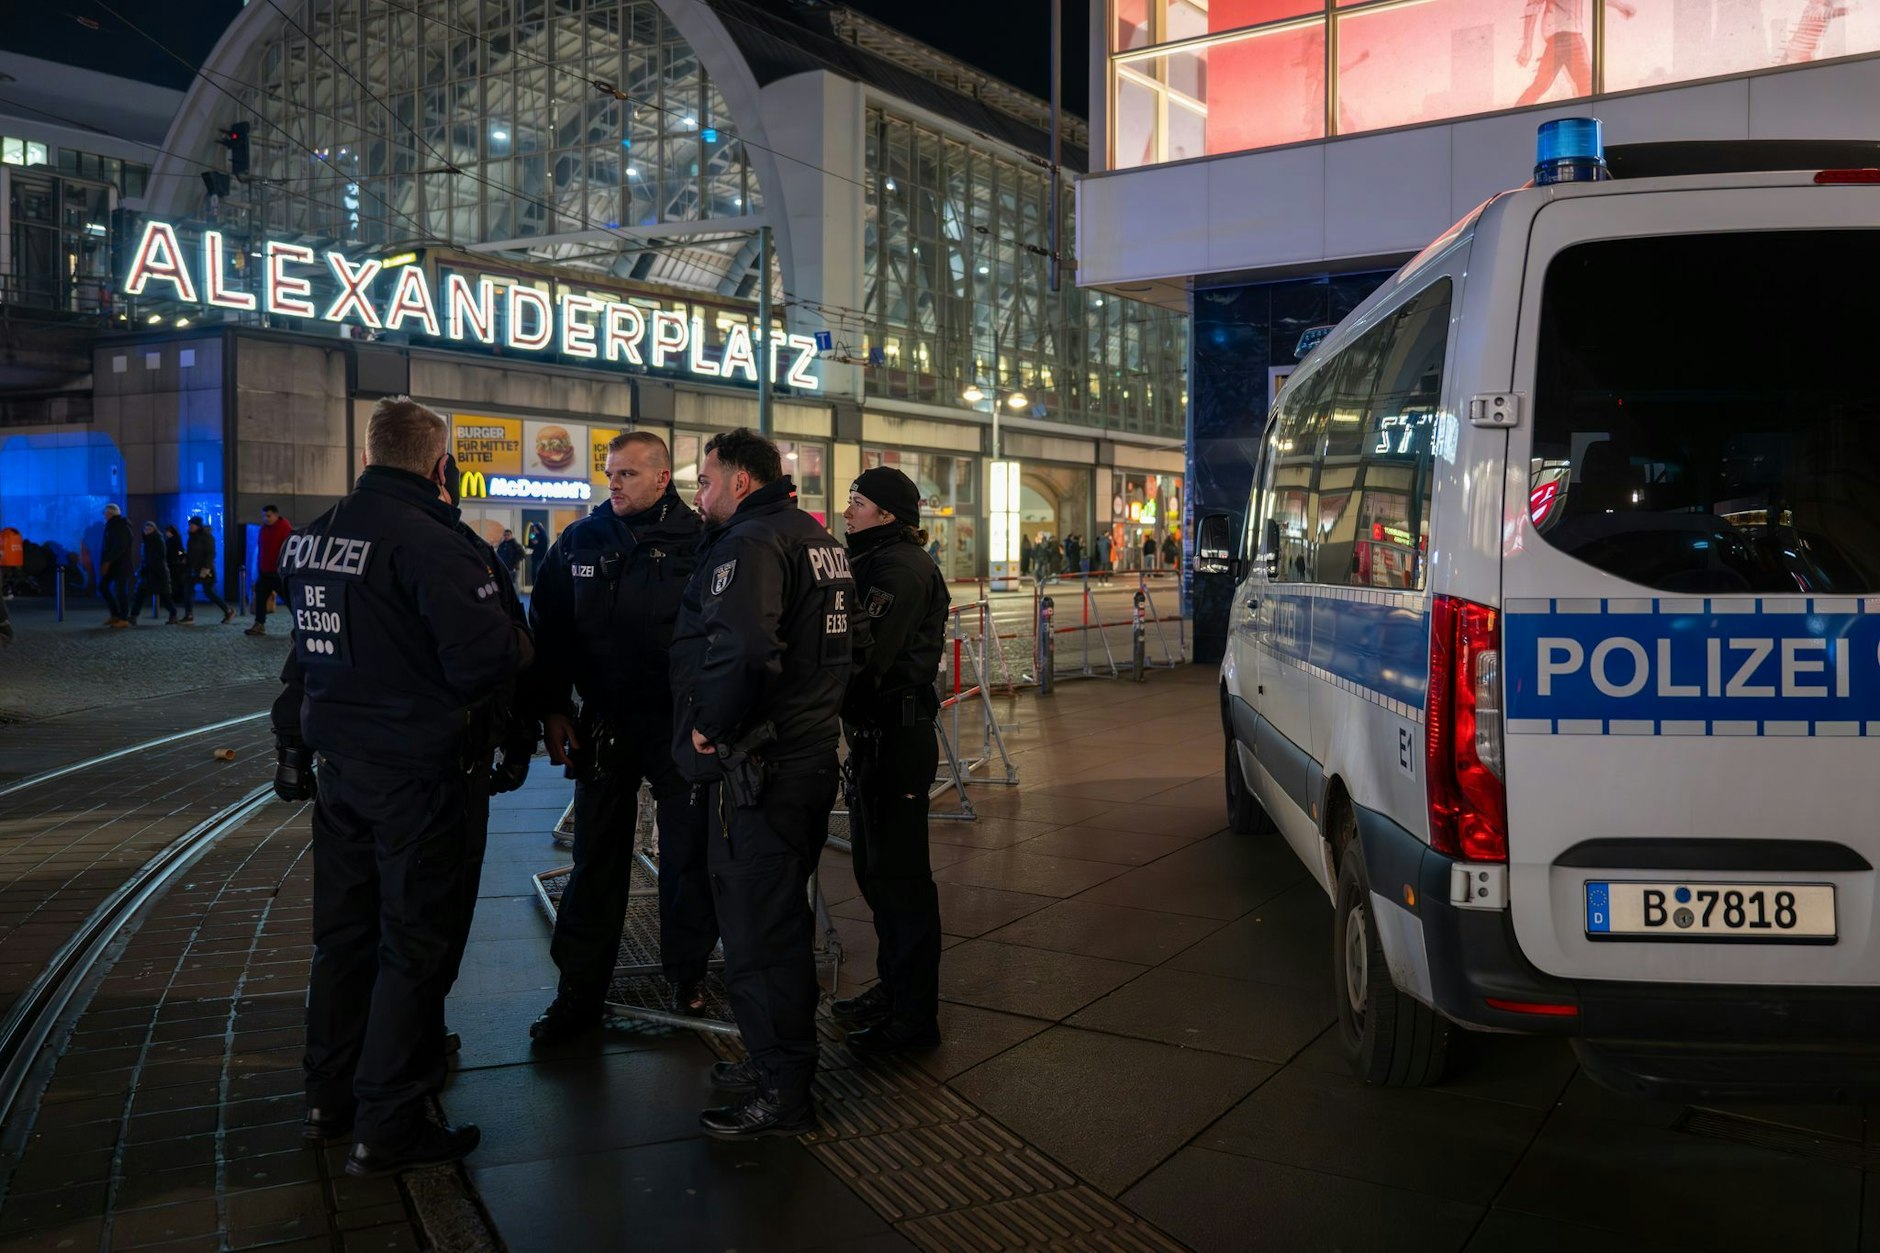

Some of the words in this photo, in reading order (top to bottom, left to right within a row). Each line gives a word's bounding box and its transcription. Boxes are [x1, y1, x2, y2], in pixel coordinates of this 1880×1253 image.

[124, 220, 820, 391] ALEXANDERPLATZ
[456, 426, 505, 440] BURGER
[456, 439, 478, 451] FÜR
[480, 440, 519, 452] MITTE?
[457, 451, 493, 463] BITTE!
[488, 477, 591, 500] McDonald's
[283, 534, 372, 575] POLIZEI
[304, 584, 326, 608] BE
[296, 608, 341, 634] E1300
[1536, 636, 1850, 699] POLIZEI
[1399, 727, 1413, 773] E1
[1593, 911, 1604, 925] D
[1643, 889, 1668, 928] B
[1696, 890, 1799, 930] 7818
